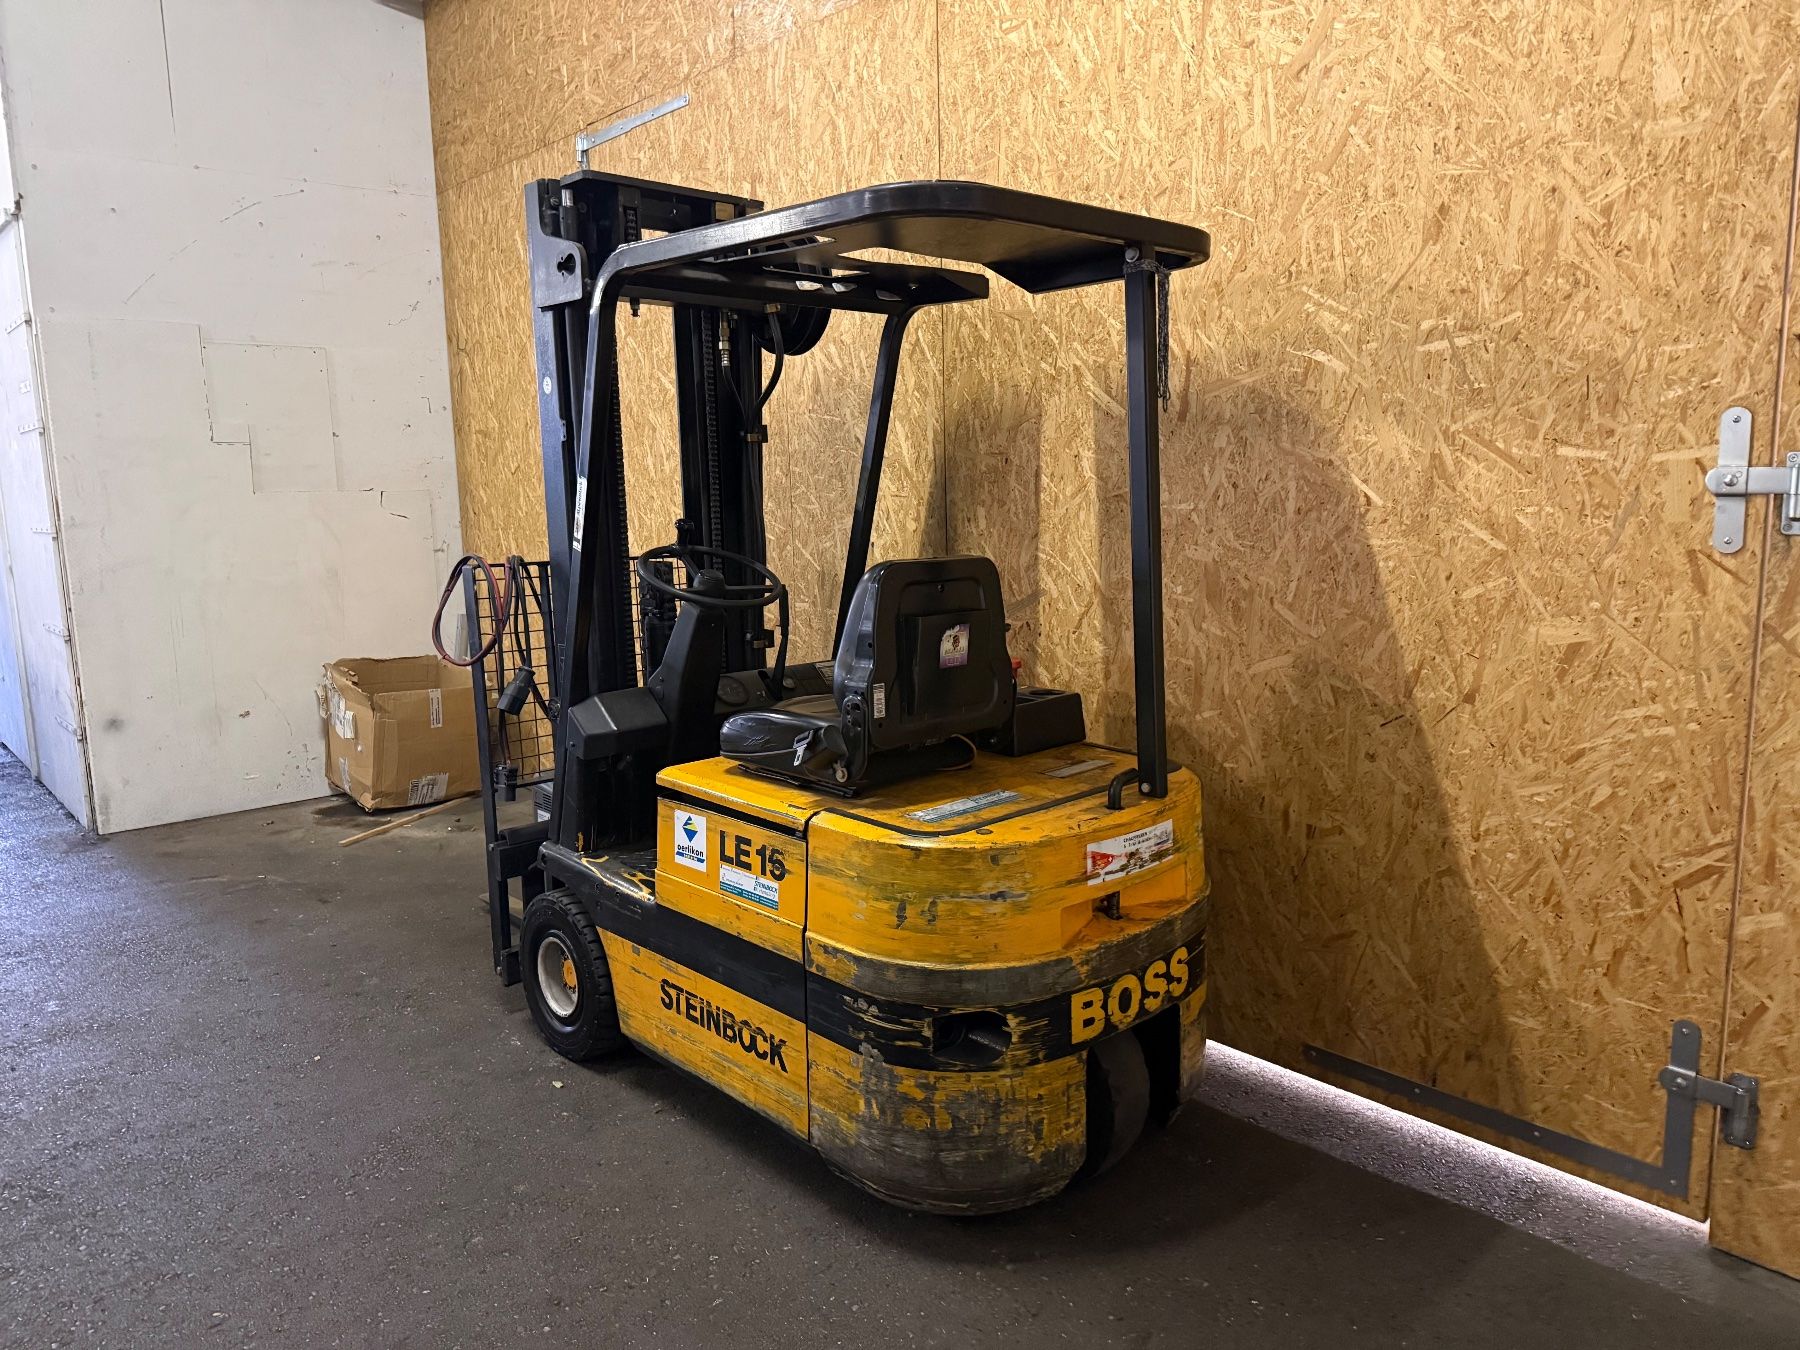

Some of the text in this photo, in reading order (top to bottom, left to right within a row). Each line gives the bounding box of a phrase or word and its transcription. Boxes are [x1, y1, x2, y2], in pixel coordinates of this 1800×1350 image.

[677, 844, 704, 858] oerlikon
[719, 829, 752, 871] LE
[660, 978, 789, 1074] STEINBOCK
[1070, 946, 1189, 1045] BOSS
